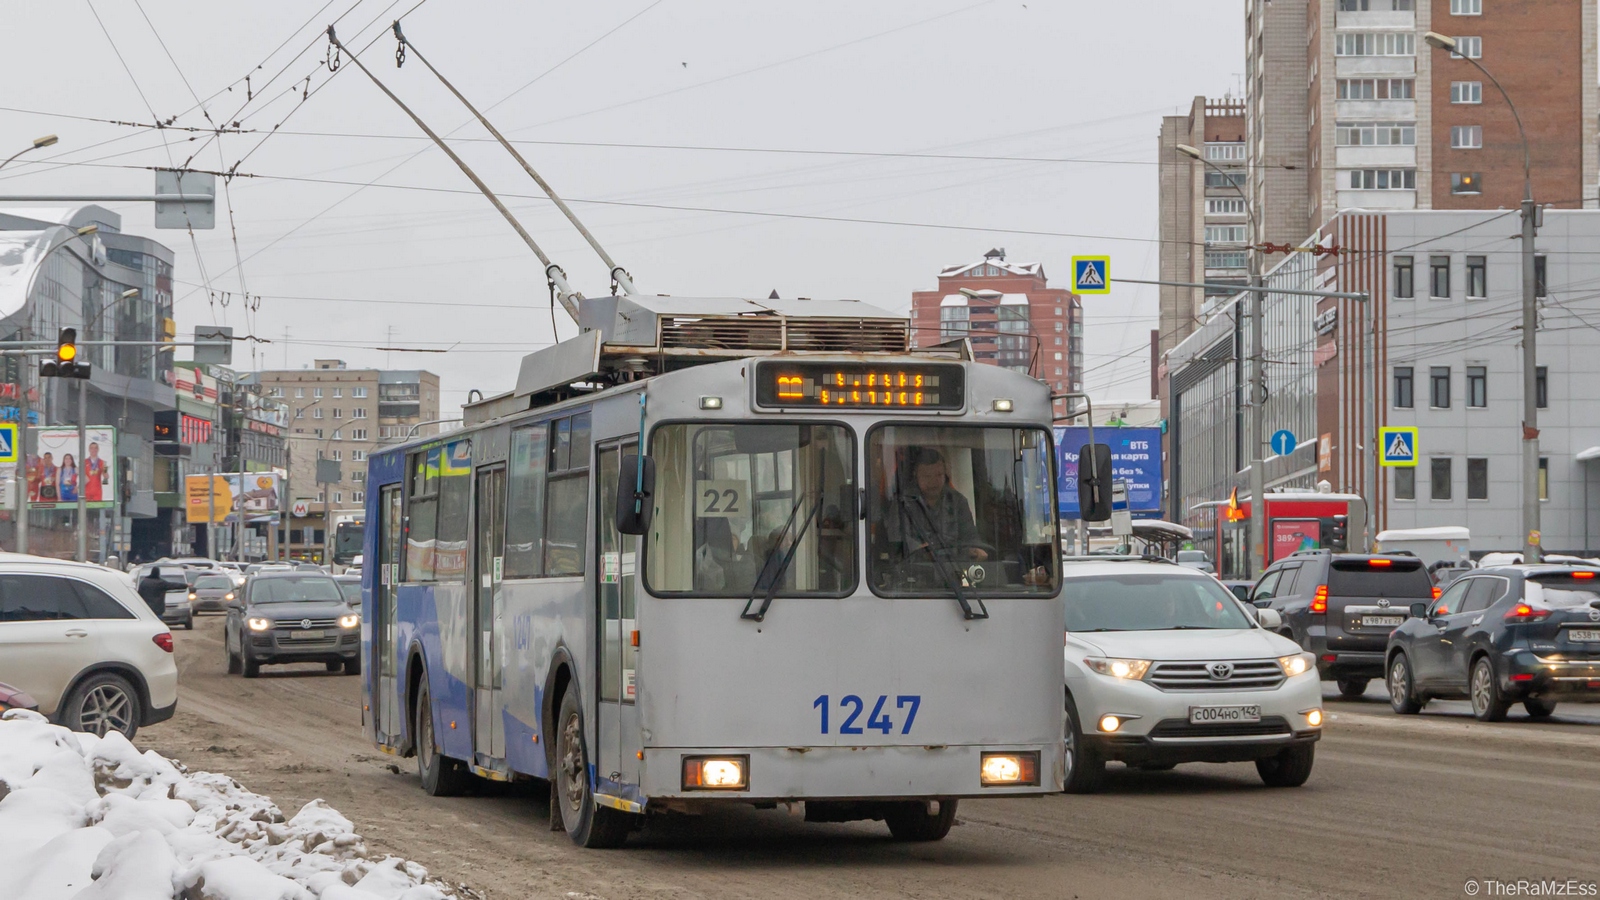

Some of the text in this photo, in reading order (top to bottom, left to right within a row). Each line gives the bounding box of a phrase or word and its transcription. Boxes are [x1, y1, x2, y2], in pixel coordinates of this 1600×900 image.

[1130, 441, 1149, 450] ВТБ
[1121, 454, 1149, 462] карта
[704, 489, 739, 513] 22
[513, 615, 531, 650] 1247
[813, 694, 922, 735] 1247
[1241, 706, 1257, 716] 142
